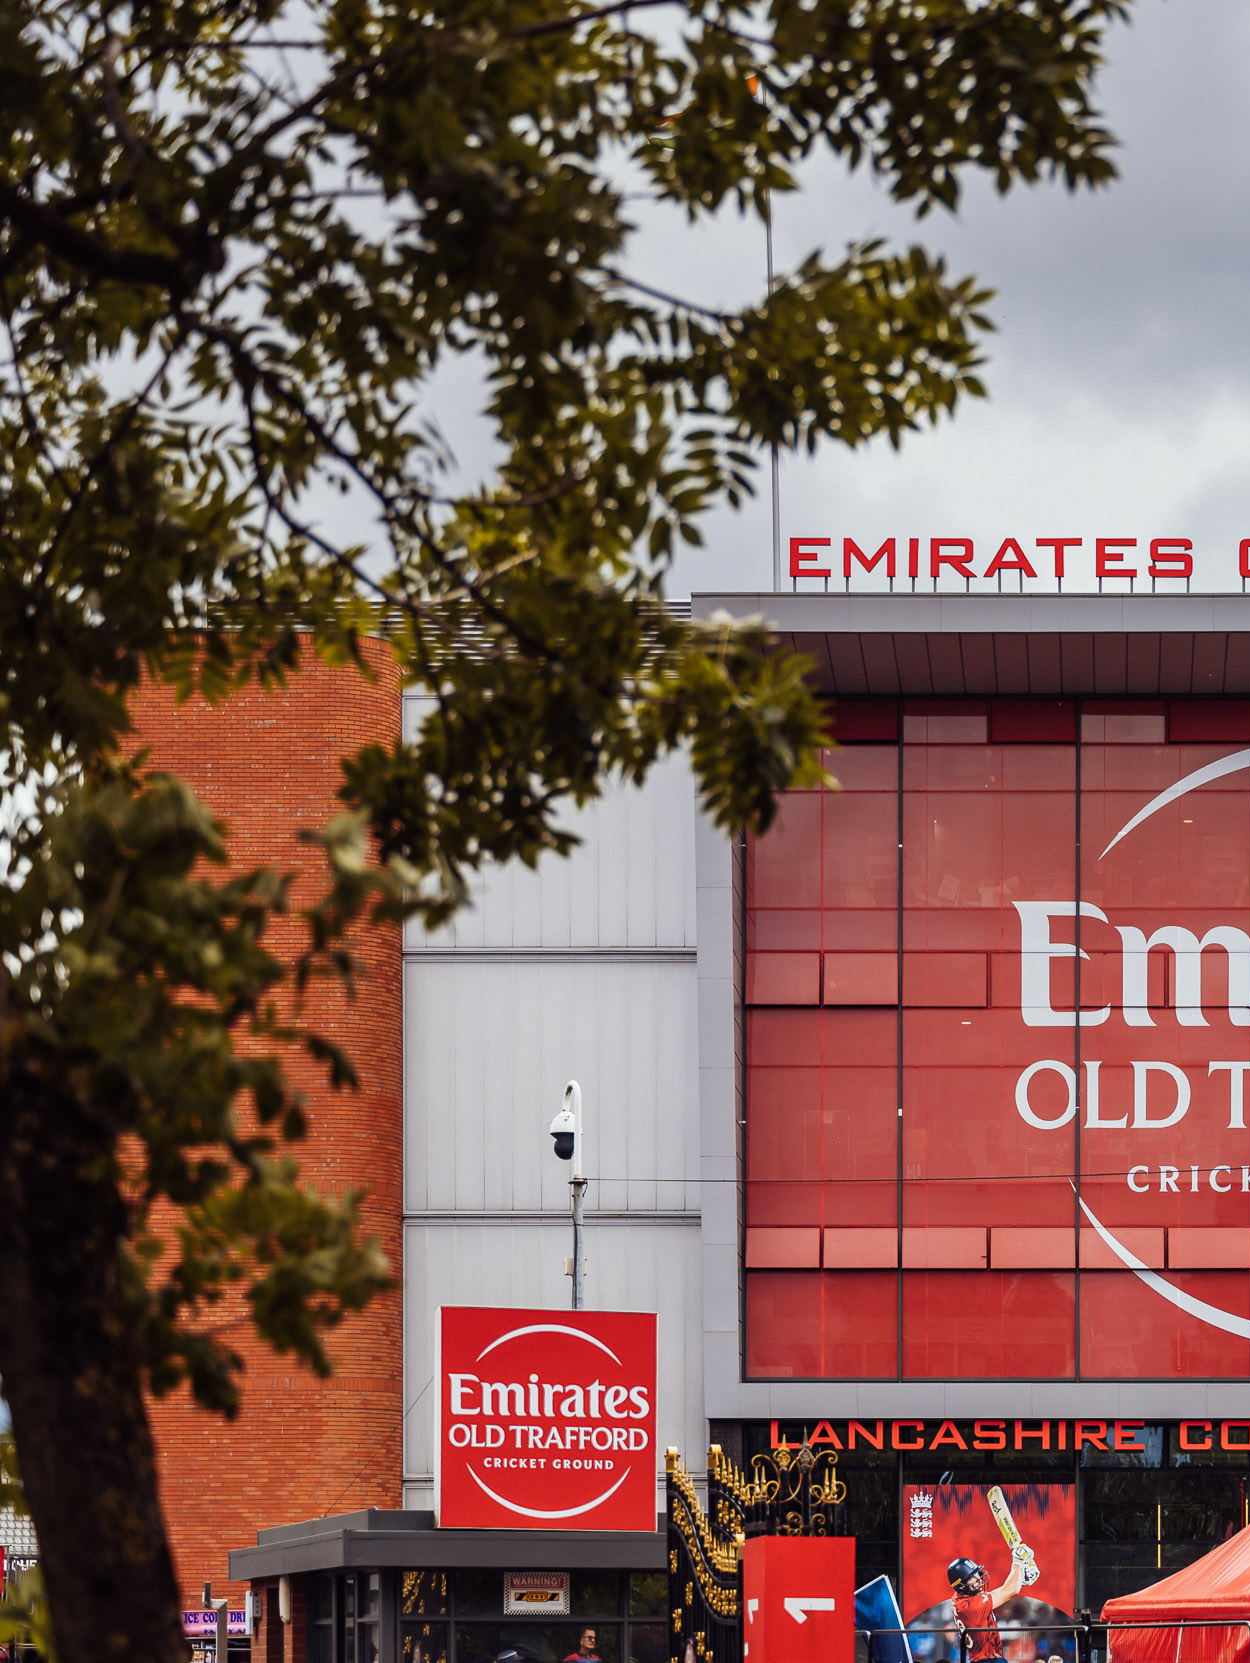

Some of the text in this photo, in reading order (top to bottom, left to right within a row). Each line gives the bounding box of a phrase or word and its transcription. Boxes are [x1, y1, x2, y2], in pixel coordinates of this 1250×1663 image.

[790, 537, 1193, 578] EMIRATES
[1014, 1059, 1191, 1130] OLD
[448, 1373, 650, 1419] Emirates
[448, 1423, 649, 1451] OLD TRAFFORD
[770, 1420, 1146, 1450] LANCASHIRE
[483, 1457, 614, 1470] CRICKET GROUND
[512, 1577, 561, 1585] WARNING!
[184, 1612, 246, 1624] ICE CO DRI
